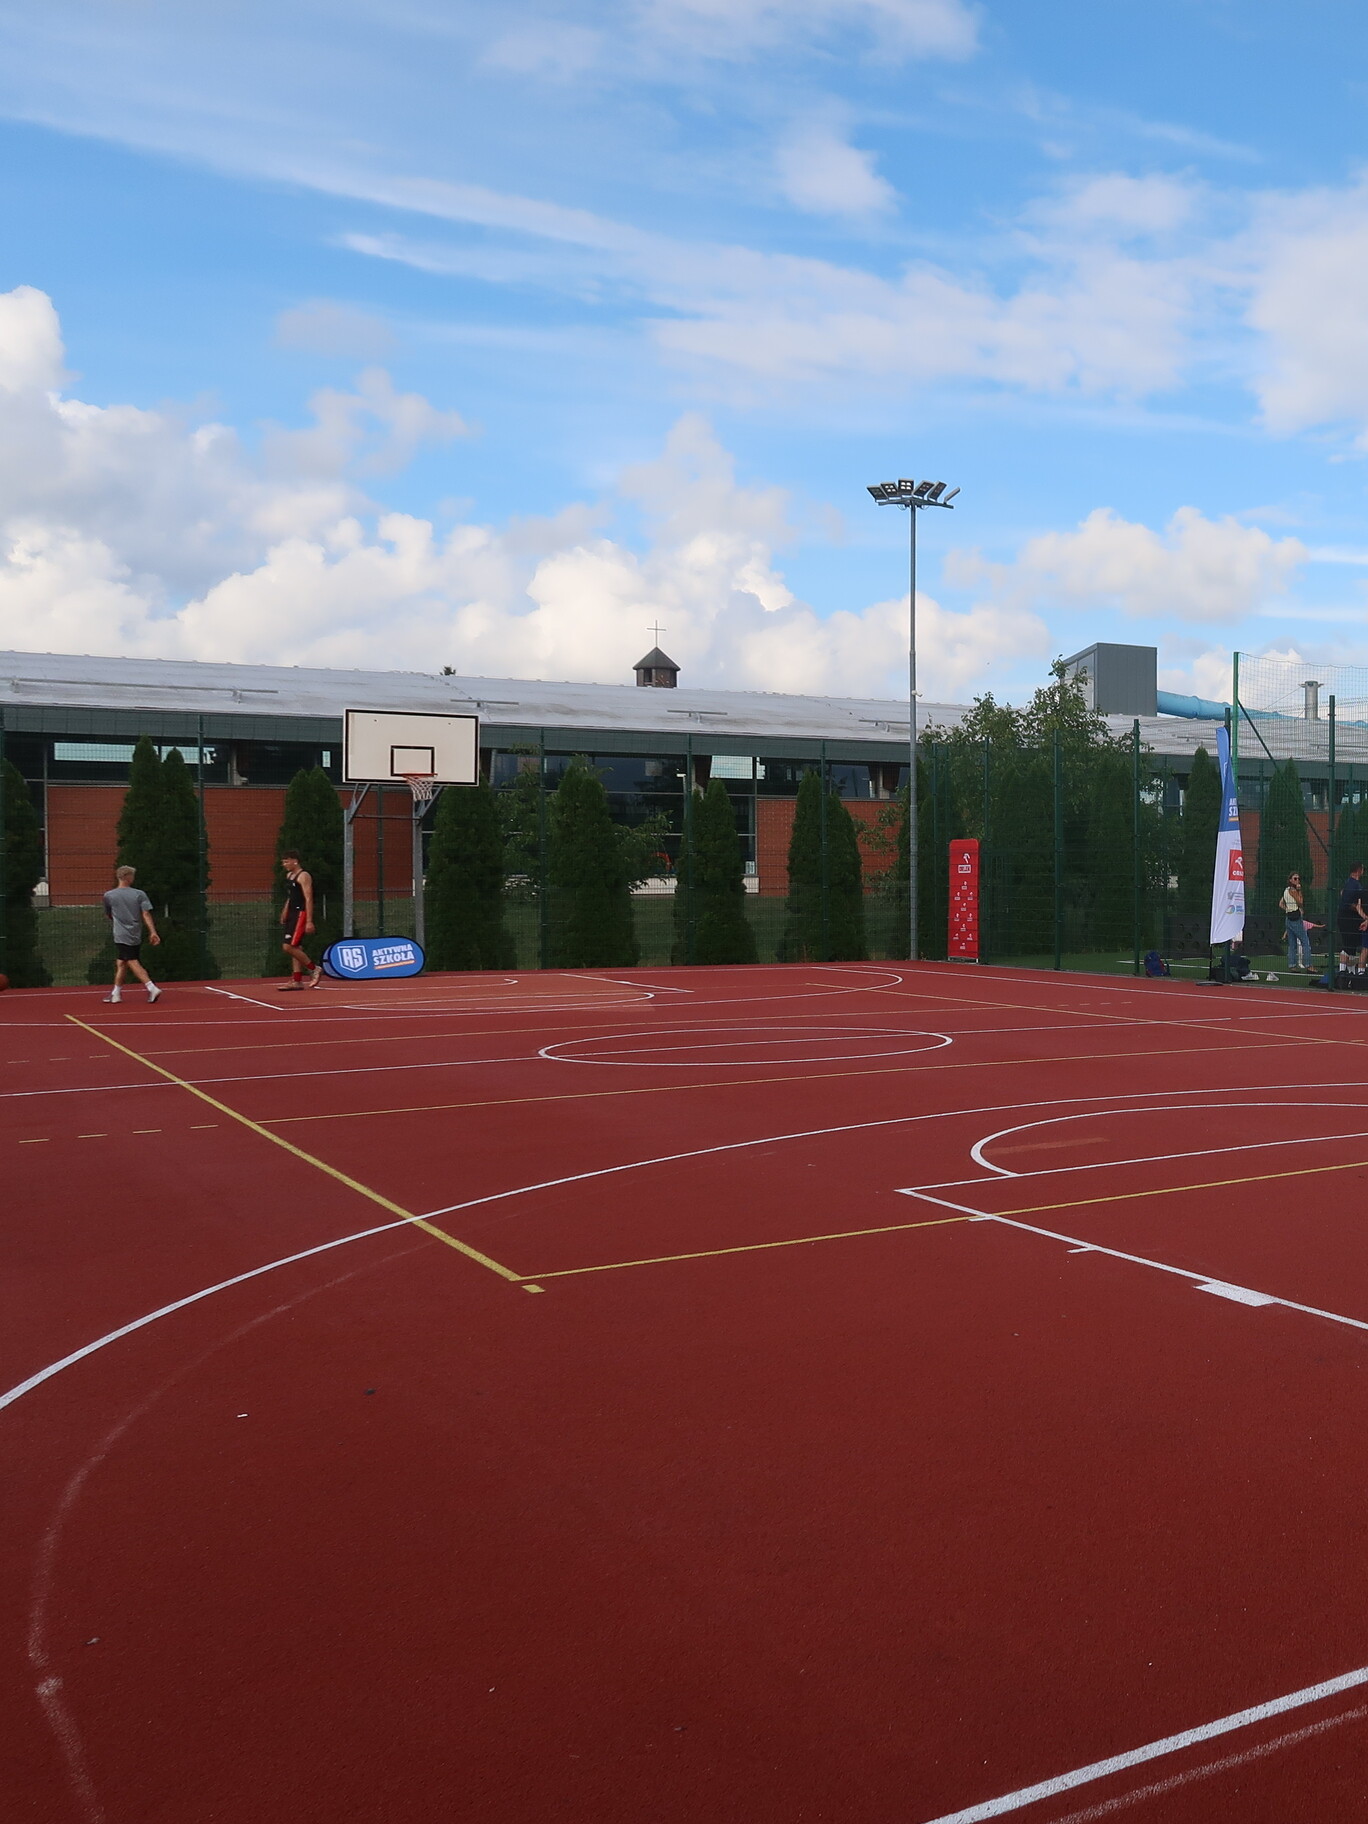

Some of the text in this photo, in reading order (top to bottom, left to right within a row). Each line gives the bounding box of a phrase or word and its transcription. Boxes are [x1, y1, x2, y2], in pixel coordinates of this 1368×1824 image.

[342, 948, 363, 968] AS
[372, 944, 413, 957] AKTYWNA
[373, 951, 415, 966] SZKOŁA
